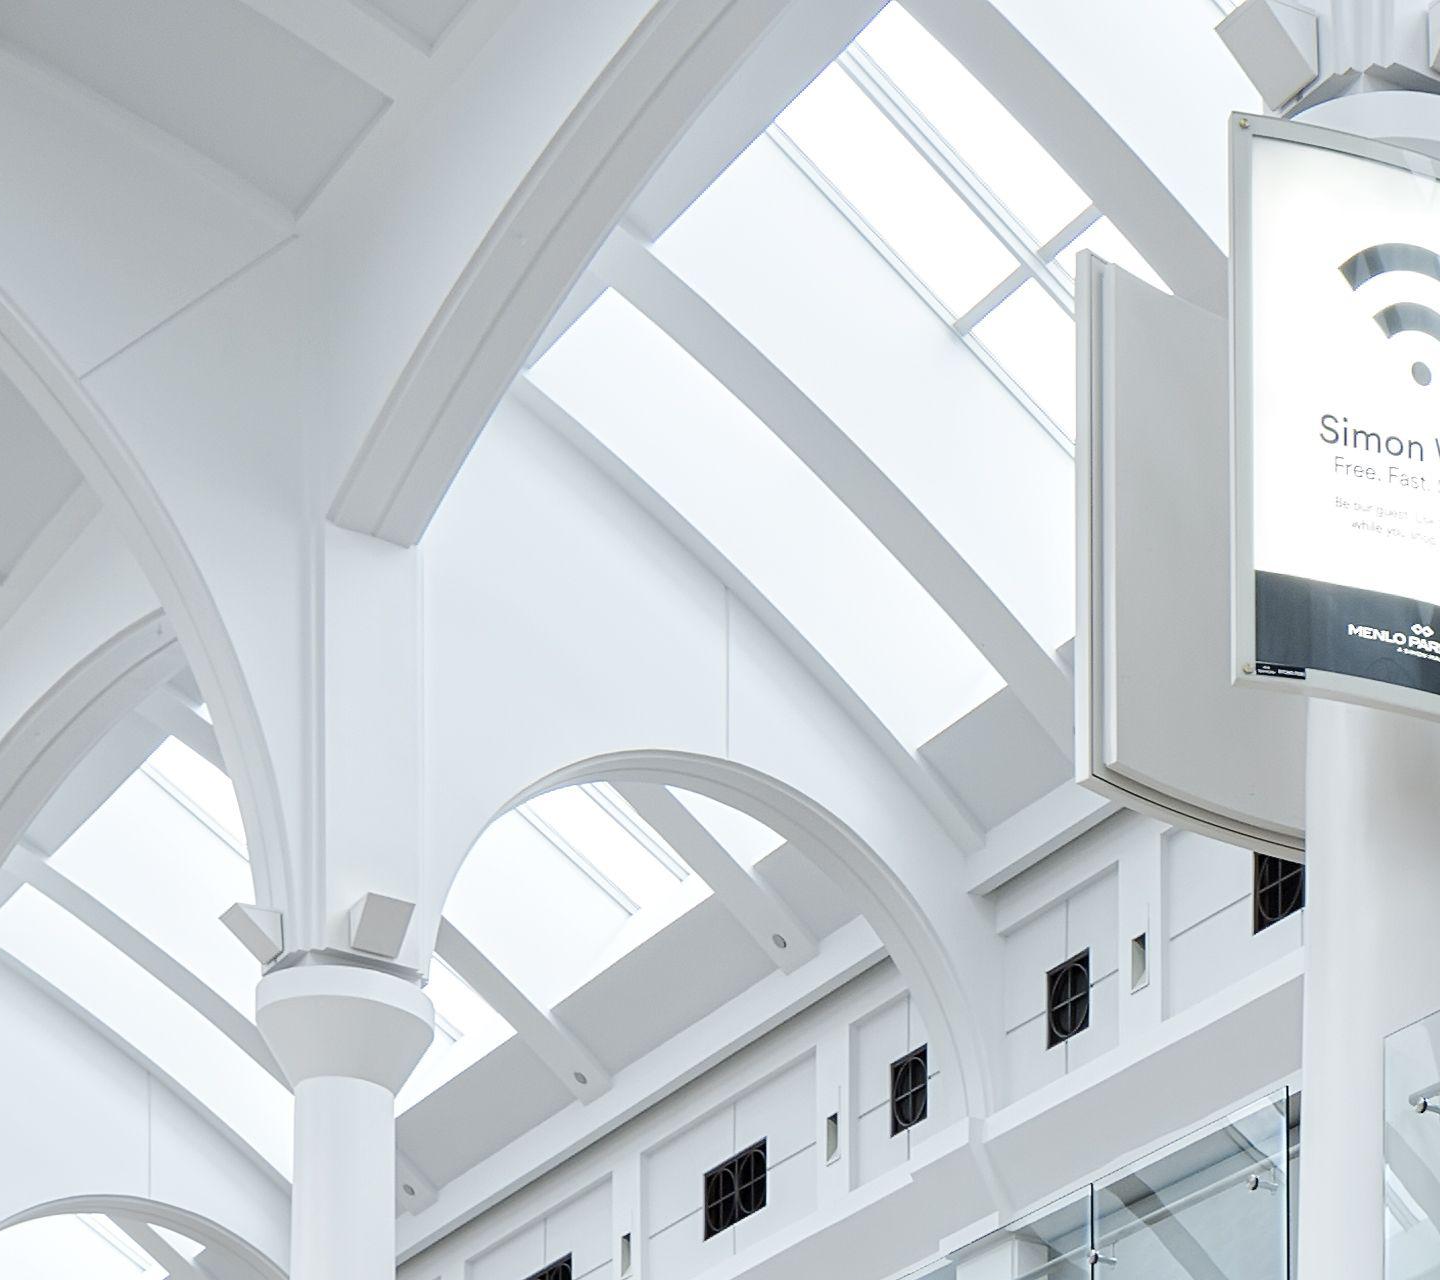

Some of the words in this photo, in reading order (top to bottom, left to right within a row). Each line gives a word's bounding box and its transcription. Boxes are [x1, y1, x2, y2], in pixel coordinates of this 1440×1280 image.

[1320, 414, 1423, 462] Simon
[1334, 456, 1381, 482] Free.
[1389, 466, 1430, 492] Fast.
[1347, 623, 1406, 645] MENLO
